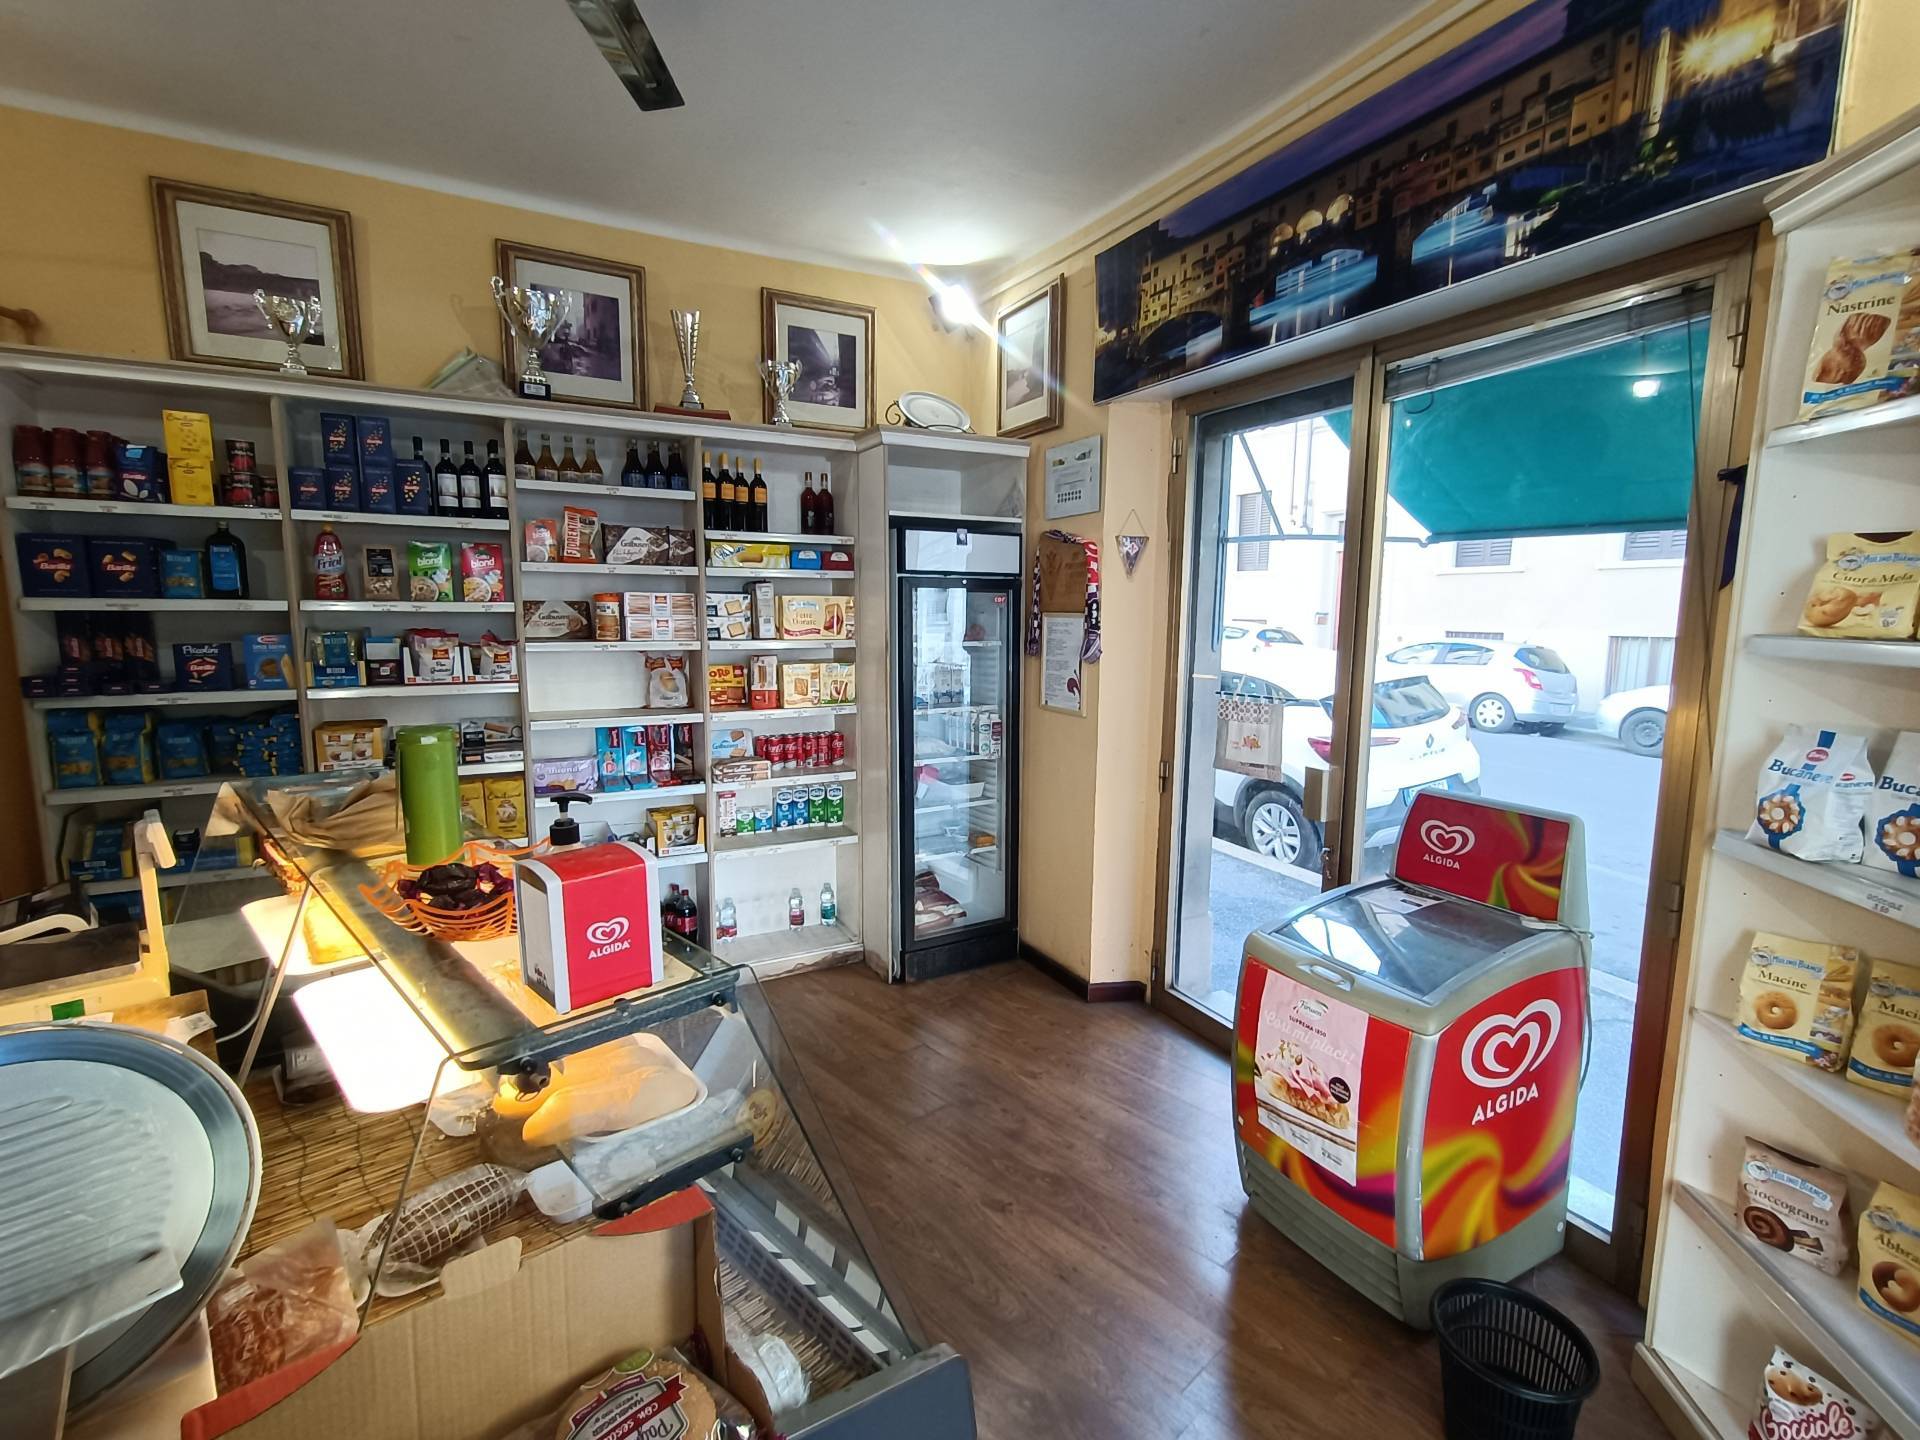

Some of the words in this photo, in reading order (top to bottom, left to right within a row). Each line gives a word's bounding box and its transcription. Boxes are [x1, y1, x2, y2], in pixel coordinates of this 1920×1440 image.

[1827, 296, 1896, 316] Nastrine
[566, 513, 580, 558] FIORENTINI
[39, 562, 71, 571] Barilla
[106, 563, 136, 572] Barilla
[316, 556, 342, 570] Friol
[417, 557, 443, 567] blond
[470, 558, 495, 568] blond
[1768, 759, 1834, 783] Bucaneve
[1422, 853, 1461, 870] ALGIDA
[588, 942, 631, 960] ALGIDA
[1757, 969, 1808, 990] Macine
[1289, 1015, 1314, 1033] SUPREMA
[1471, 1082, 1539, 1126] ALGIDA
[1743, 1183, 1830, 1227] Cioccograno
[592, 1397, 645, 1437] HAMBURGER
[636, 1402, 659, 1420] con
[1761, 1401, 1854, 1440] Gocciole
